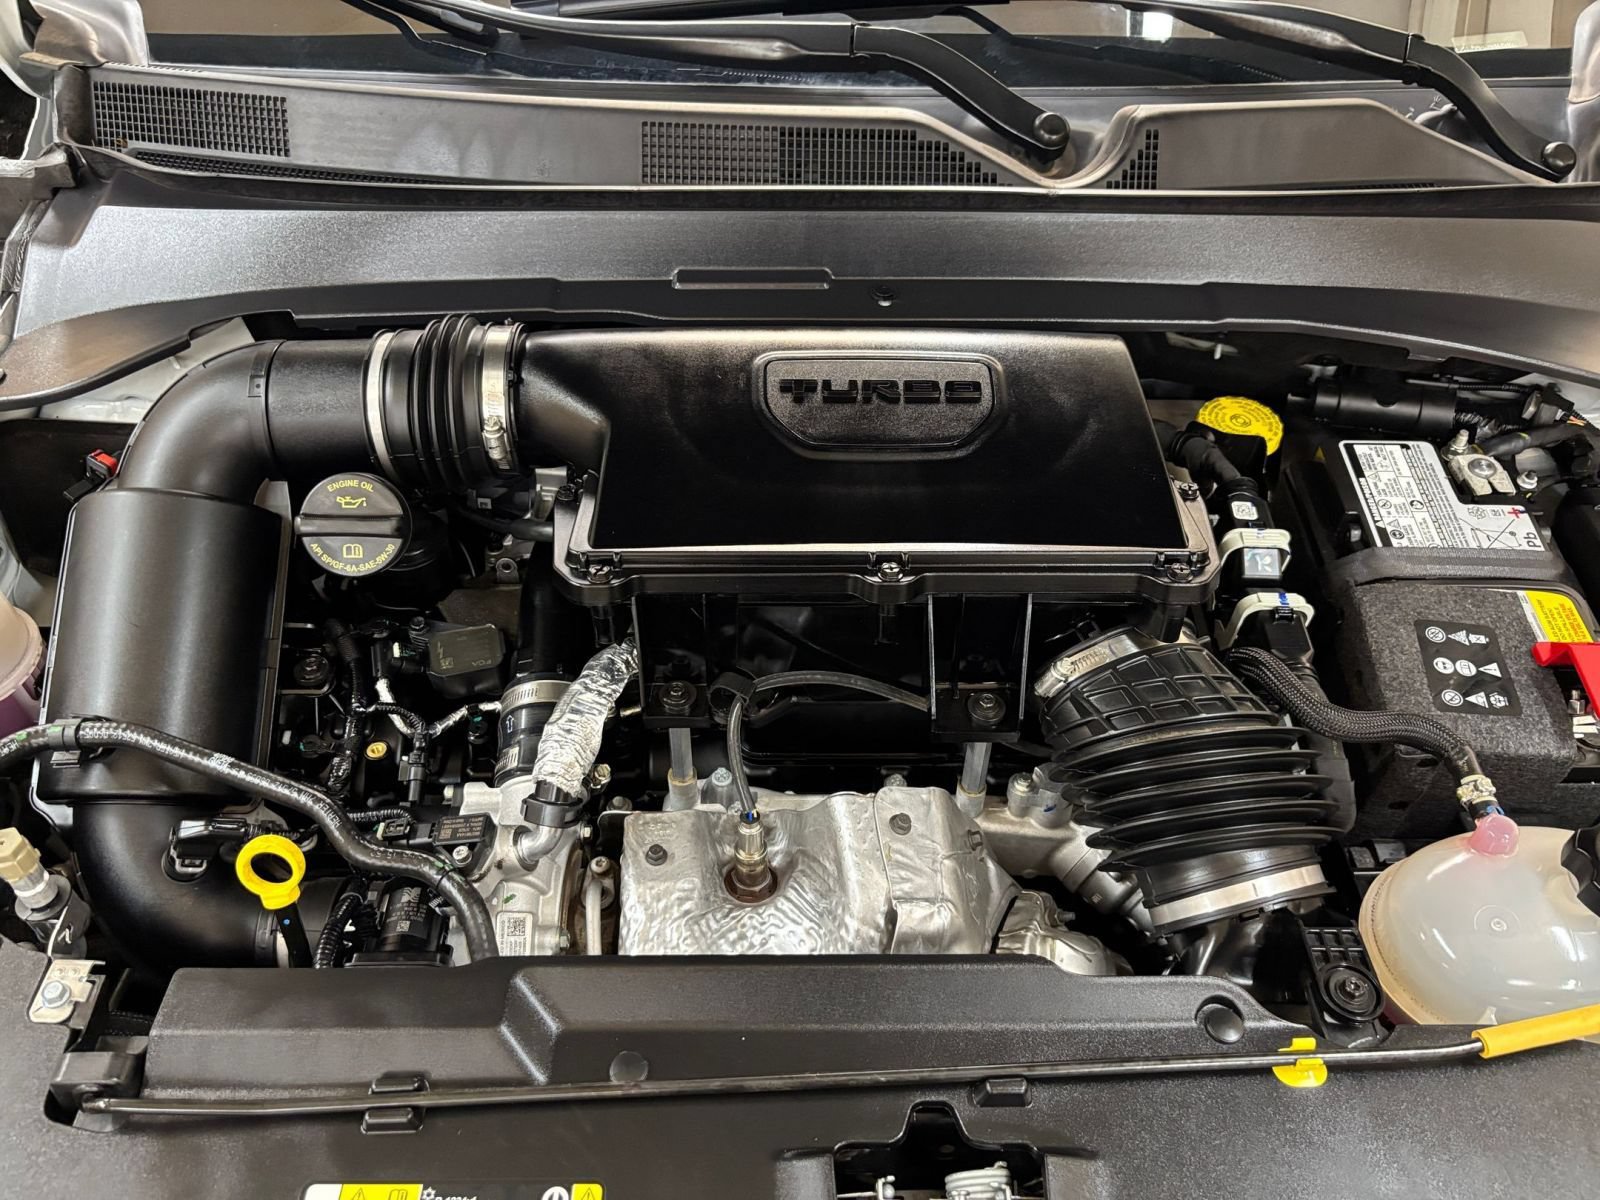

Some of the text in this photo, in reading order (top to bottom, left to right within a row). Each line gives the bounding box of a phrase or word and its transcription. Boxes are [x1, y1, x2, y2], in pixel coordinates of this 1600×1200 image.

[780, 379, 981, 403] TURBO
[327, 480, 374, 492] ENGINE OIL
[310, 543, 323, 557] API
